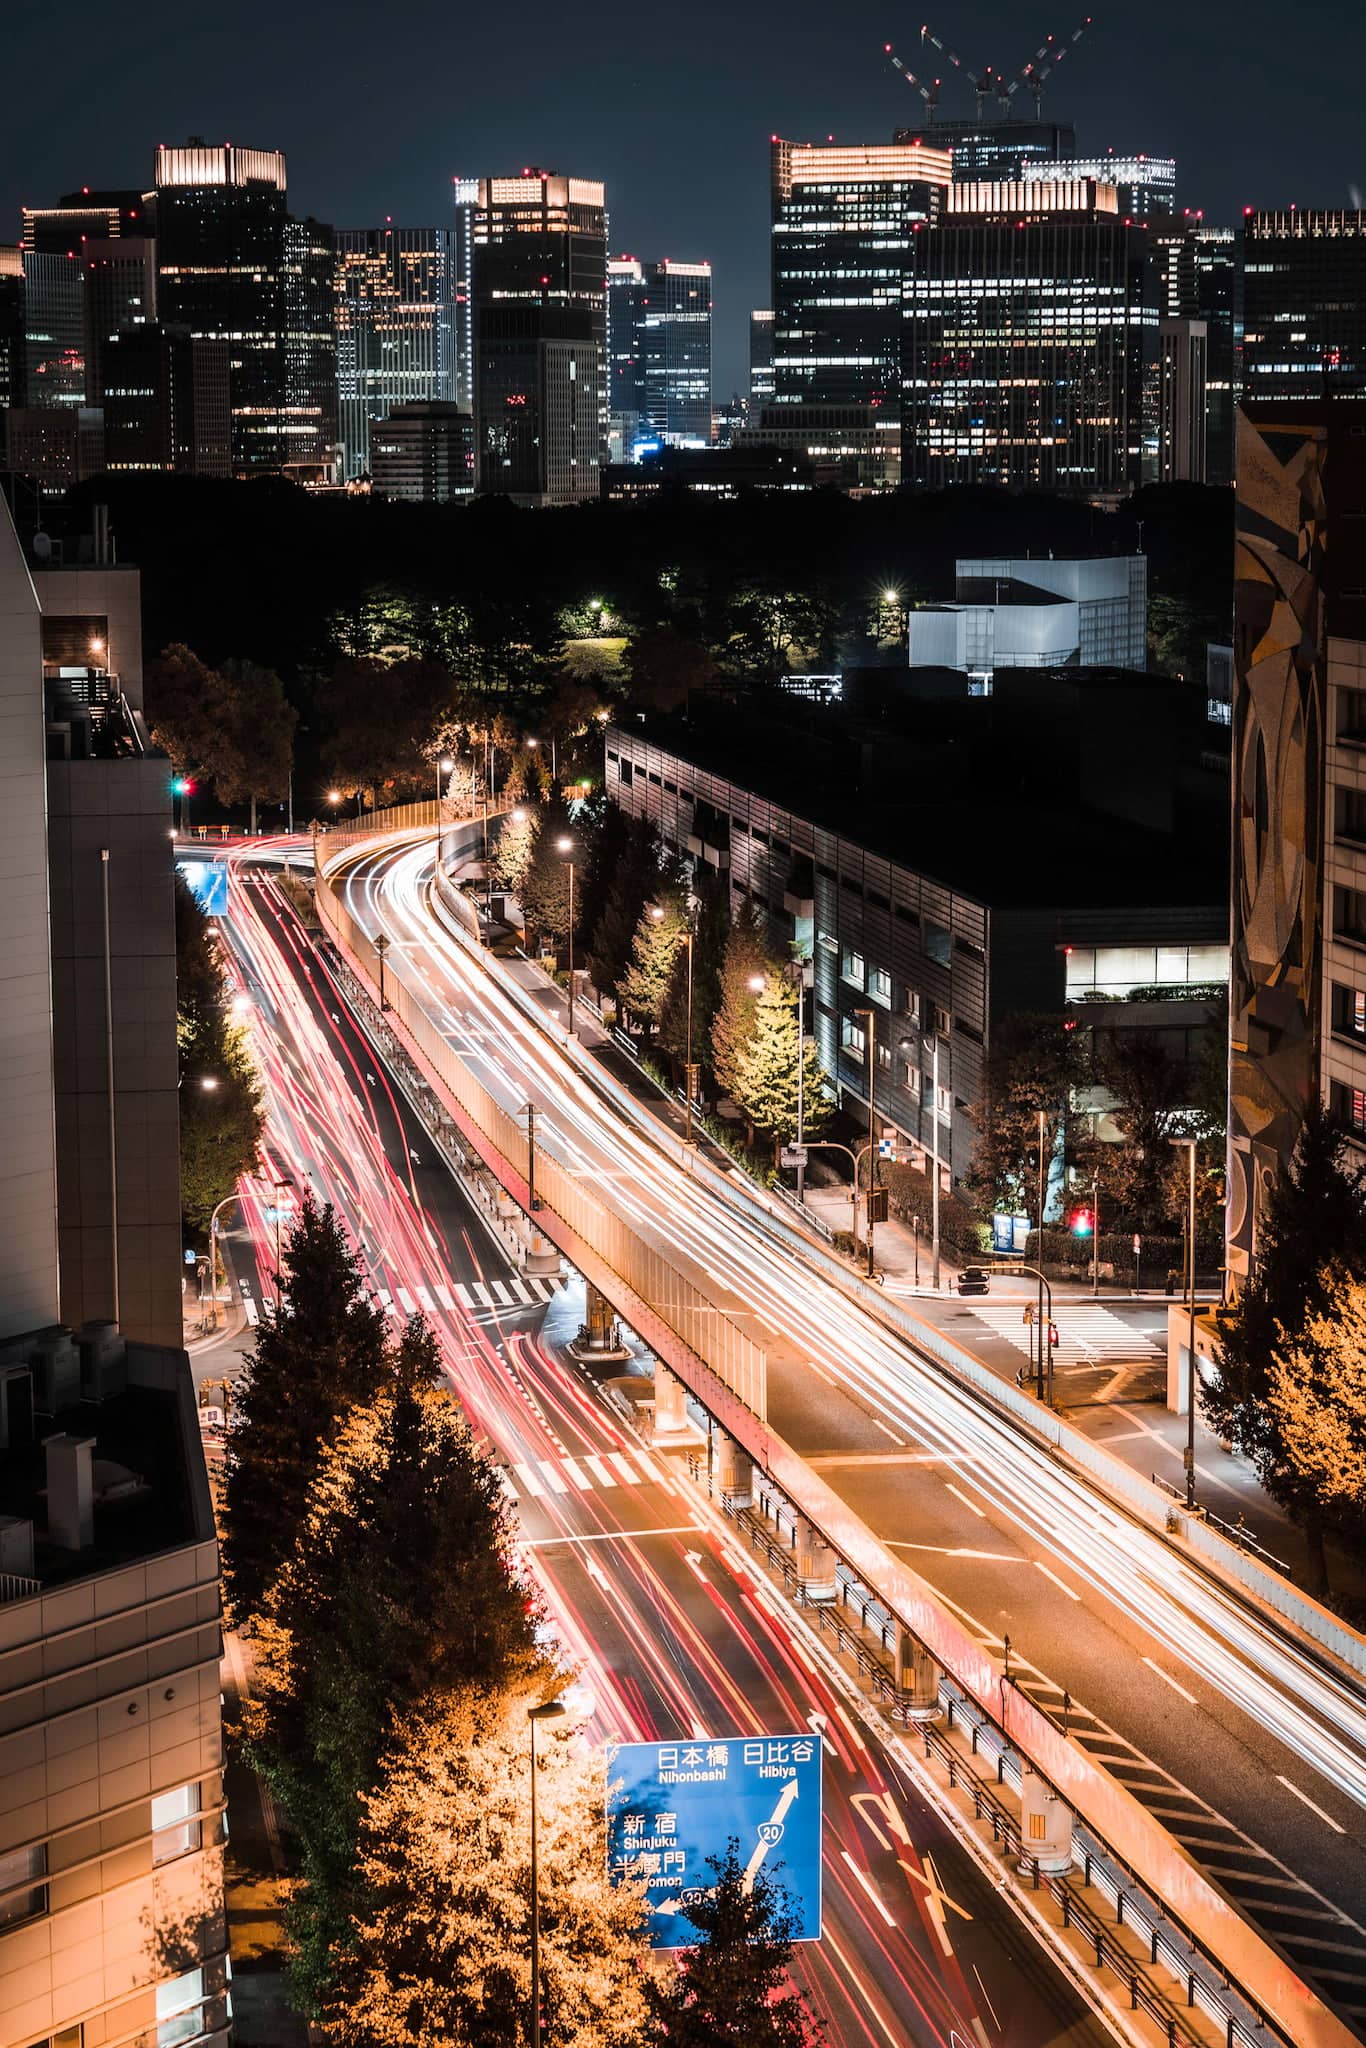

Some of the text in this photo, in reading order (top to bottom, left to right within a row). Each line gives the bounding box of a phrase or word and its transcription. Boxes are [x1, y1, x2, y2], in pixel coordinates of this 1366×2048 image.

[658, 1745, 729, 1770] 日本橋
[743, 1740, 814, 1765] 日比谷
[659, 1769, 726, 1784] Nihonbashi
[759, 1765, 796, 1780] Hibiya
[763, 1826, 779, 1839] 20
[623, 1837, 677, 1850] Shinjuku
